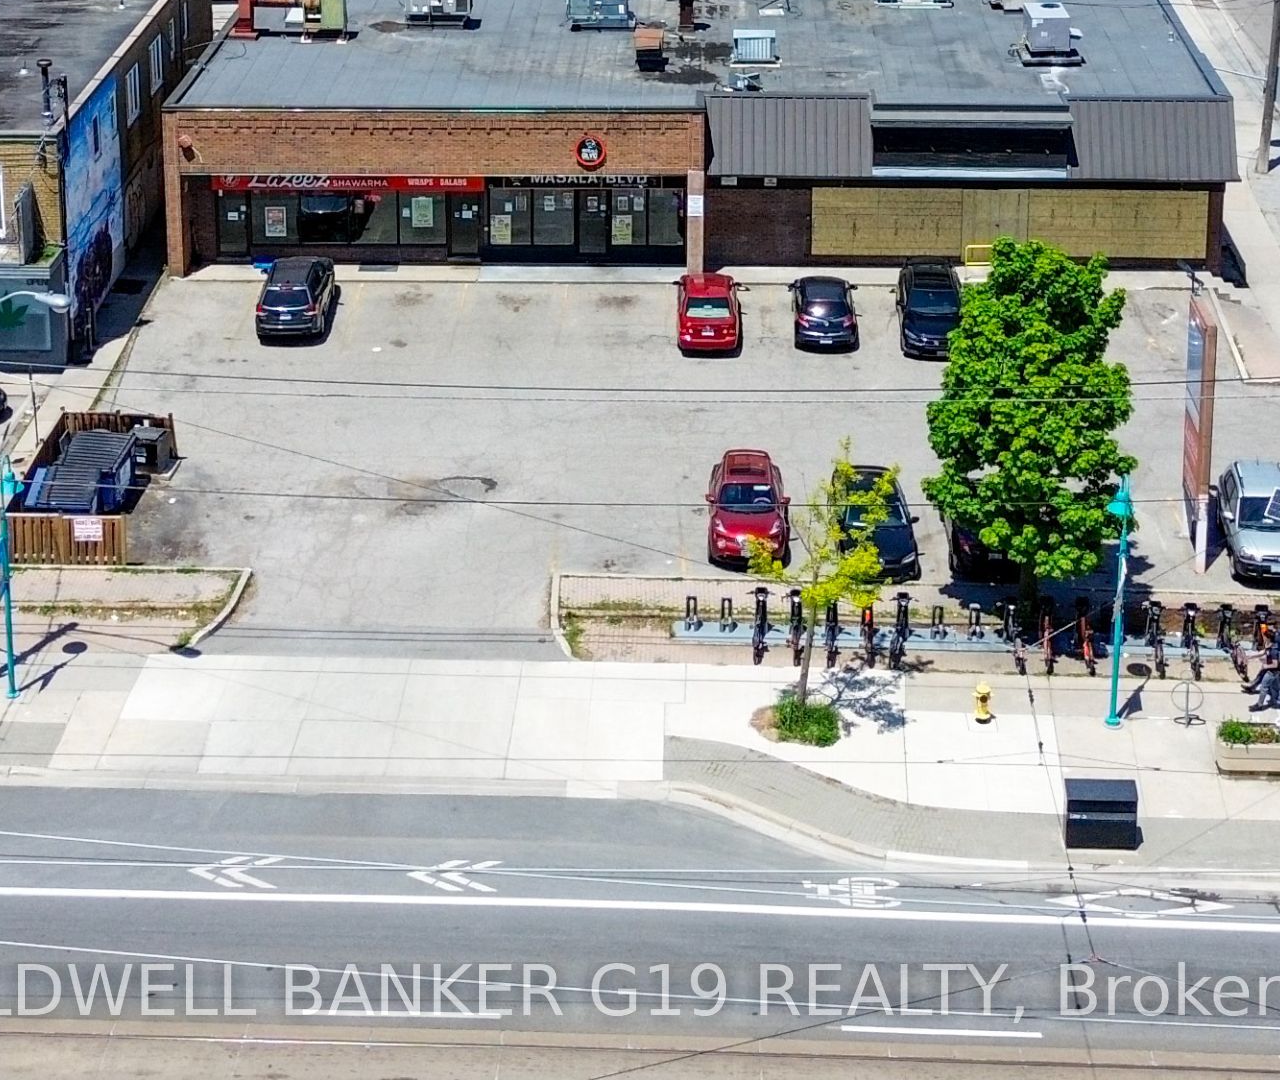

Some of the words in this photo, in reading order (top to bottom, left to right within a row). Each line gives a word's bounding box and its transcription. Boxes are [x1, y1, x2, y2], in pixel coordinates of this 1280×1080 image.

[332, 179, 389, 187] SHAWARMA
[530, 175, 598, 184] MASALA
[606, 175, 648, 184] BLVD
